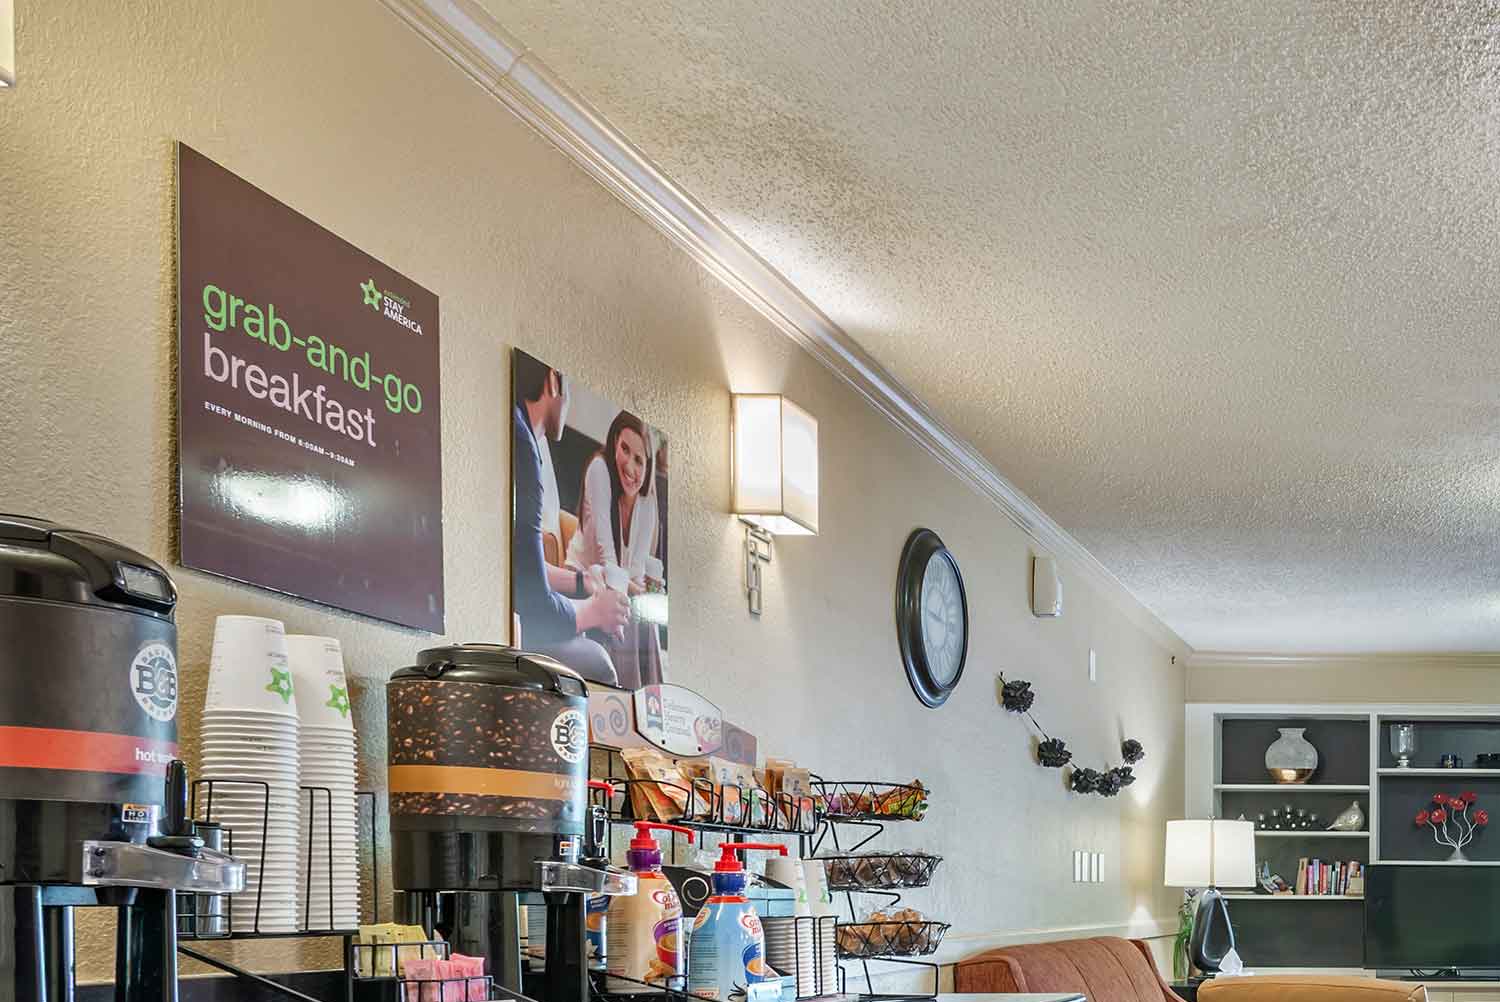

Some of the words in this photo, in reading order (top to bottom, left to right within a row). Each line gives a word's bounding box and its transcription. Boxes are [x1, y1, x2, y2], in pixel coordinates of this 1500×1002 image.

[384, 296, 403, 314] STAY
[384, 307, 422, 335] AMERICA
[203, 284, 423, 414] grab-and-go
[204, 332, 376, 448] breakfast
[205, 401, 232, 418] EVERY
[234, 413, 273, 434] MORNING
[274, 428, 297, 443] FROM
[135, 747, 156, 762] hot
